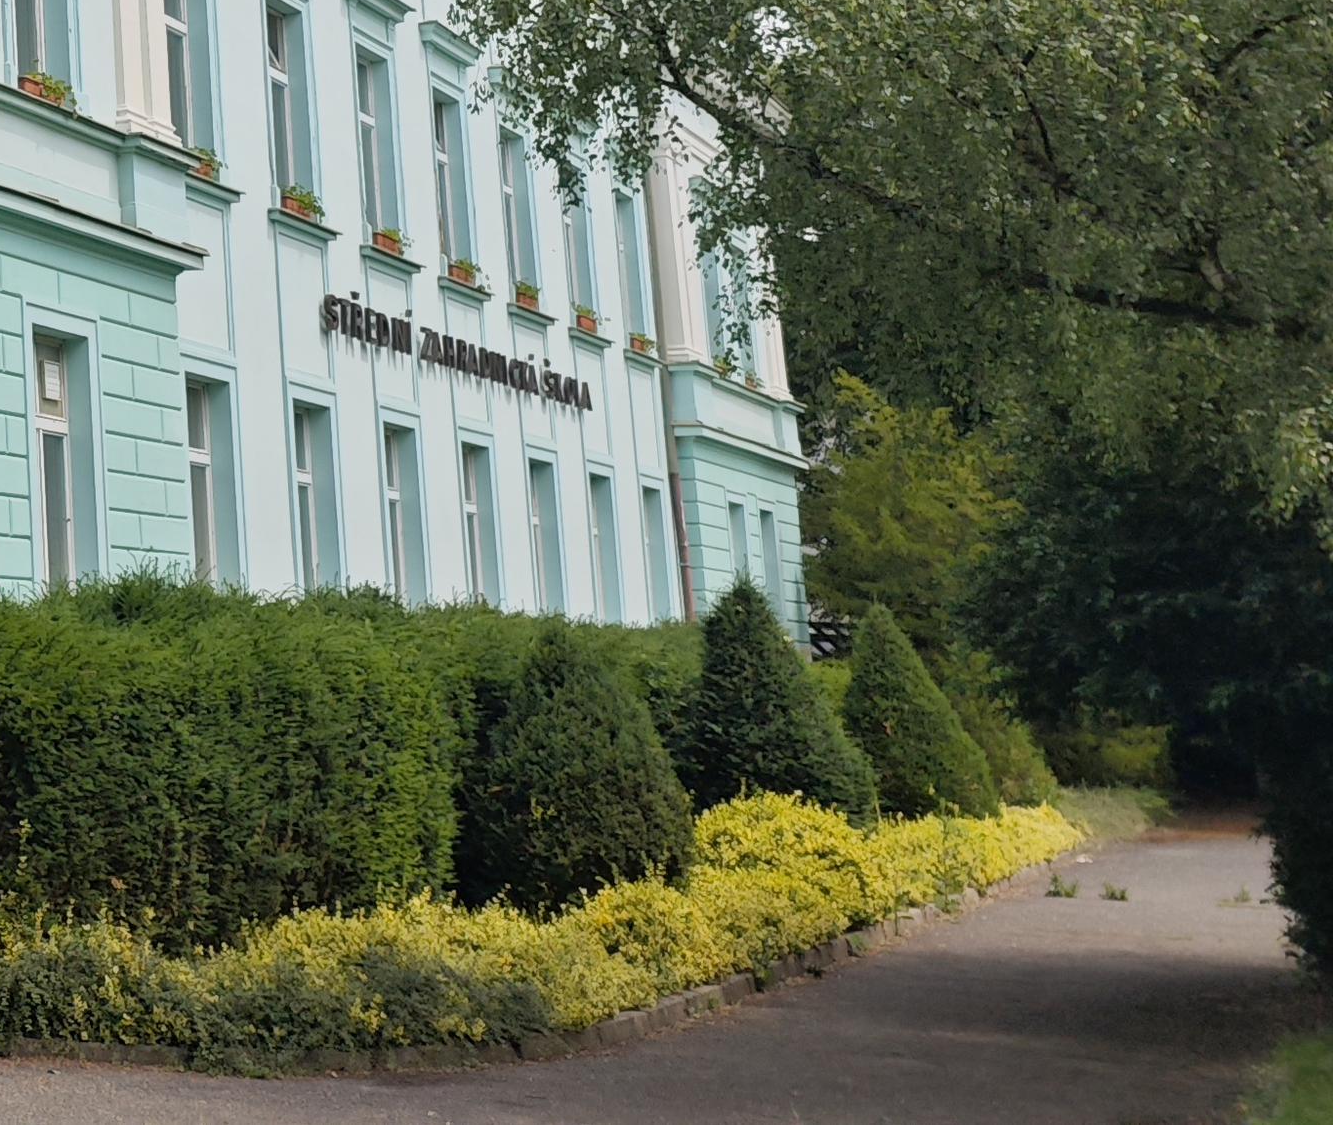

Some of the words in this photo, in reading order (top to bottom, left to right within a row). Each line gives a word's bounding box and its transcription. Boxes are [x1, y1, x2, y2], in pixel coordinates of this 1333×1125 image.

[323, 291, 412, 355] STŘEDNÍ
[419, 326, 539, 396] ZAHRADNICKÁ
[542, 358, 594, 412] ŠKOLA
